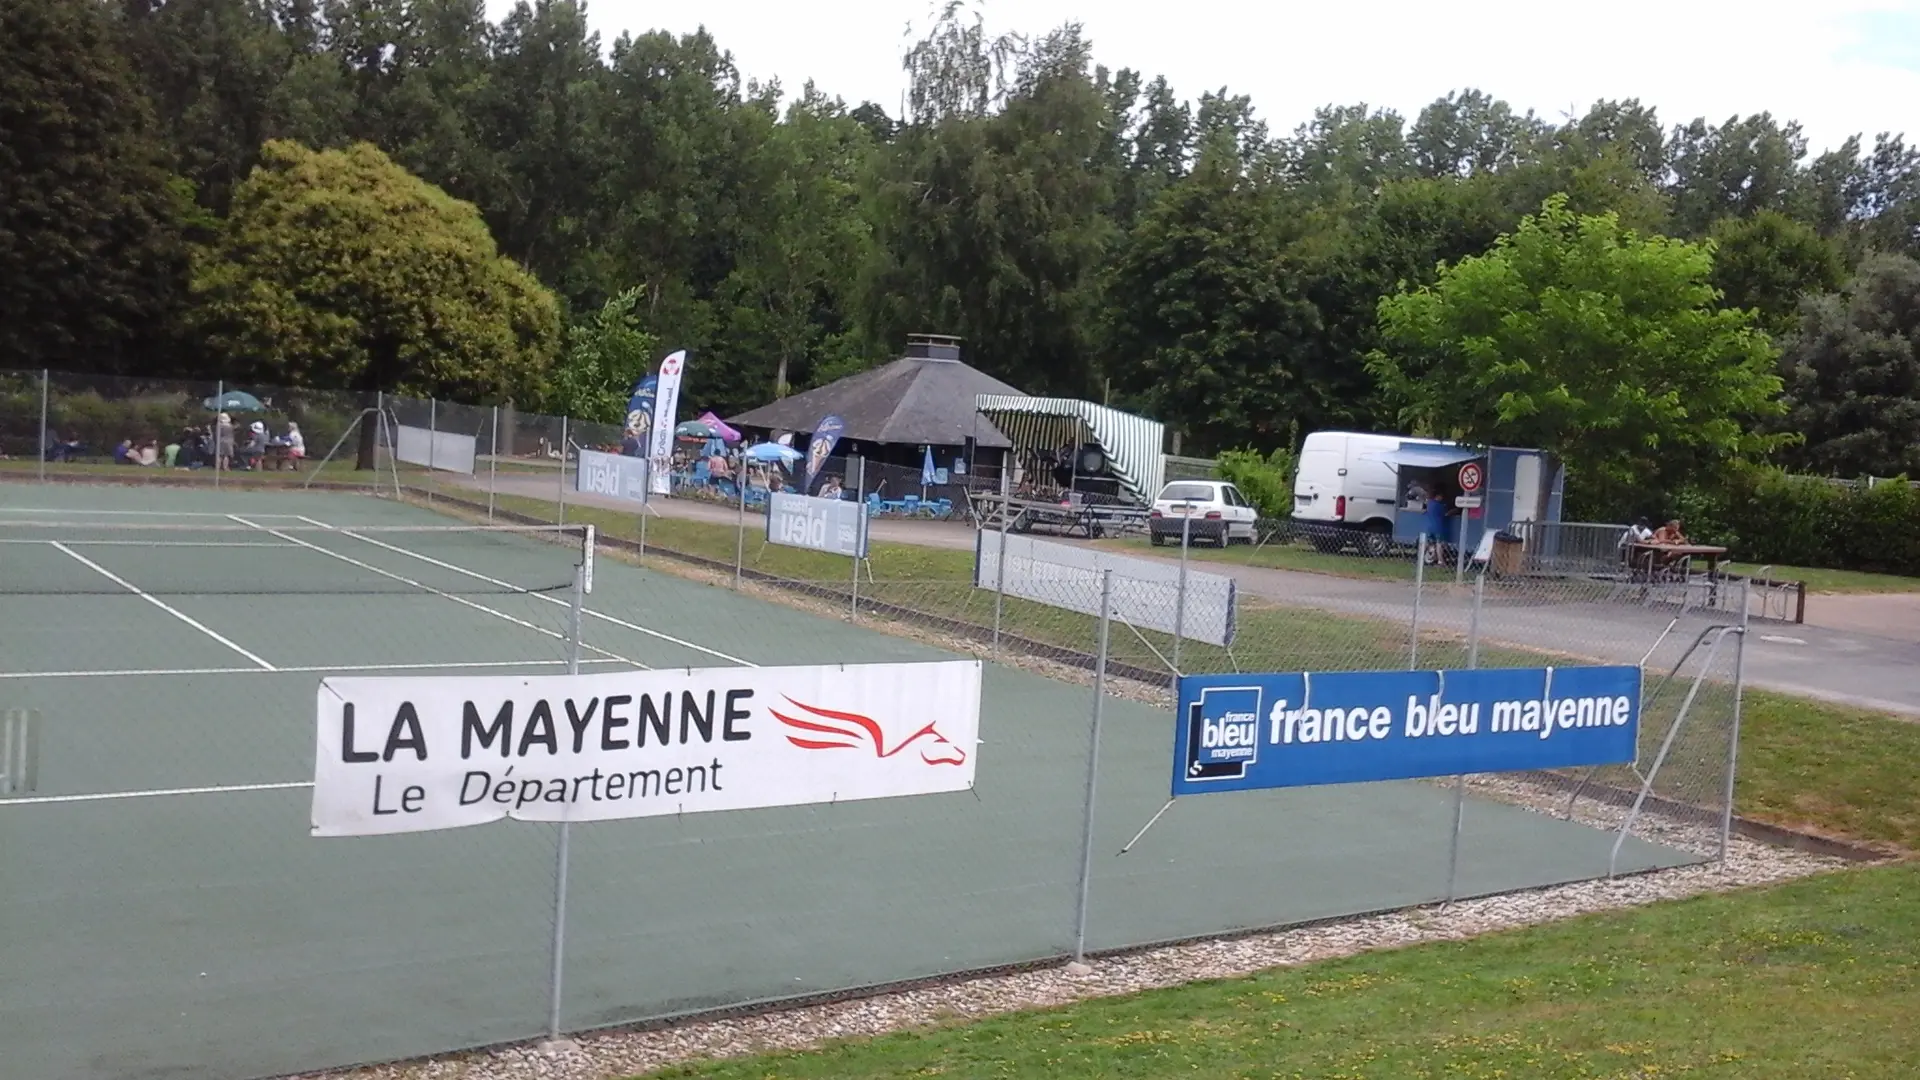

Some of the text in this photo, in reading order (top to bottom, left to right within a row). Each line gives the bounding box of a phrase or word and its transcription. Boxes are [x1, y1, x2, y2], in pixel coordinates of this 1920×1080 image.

[342, 688, 754, 763] LA MAYENNE
[1202, 716, 1255, 748] bleu
[1225, 711, 1256, 723] france
[1269, 691, 1630, 744] france bleu mayenne
[1210, 747, 1253, 760] mayenne
[373, 757, 723, 815] Le Département
